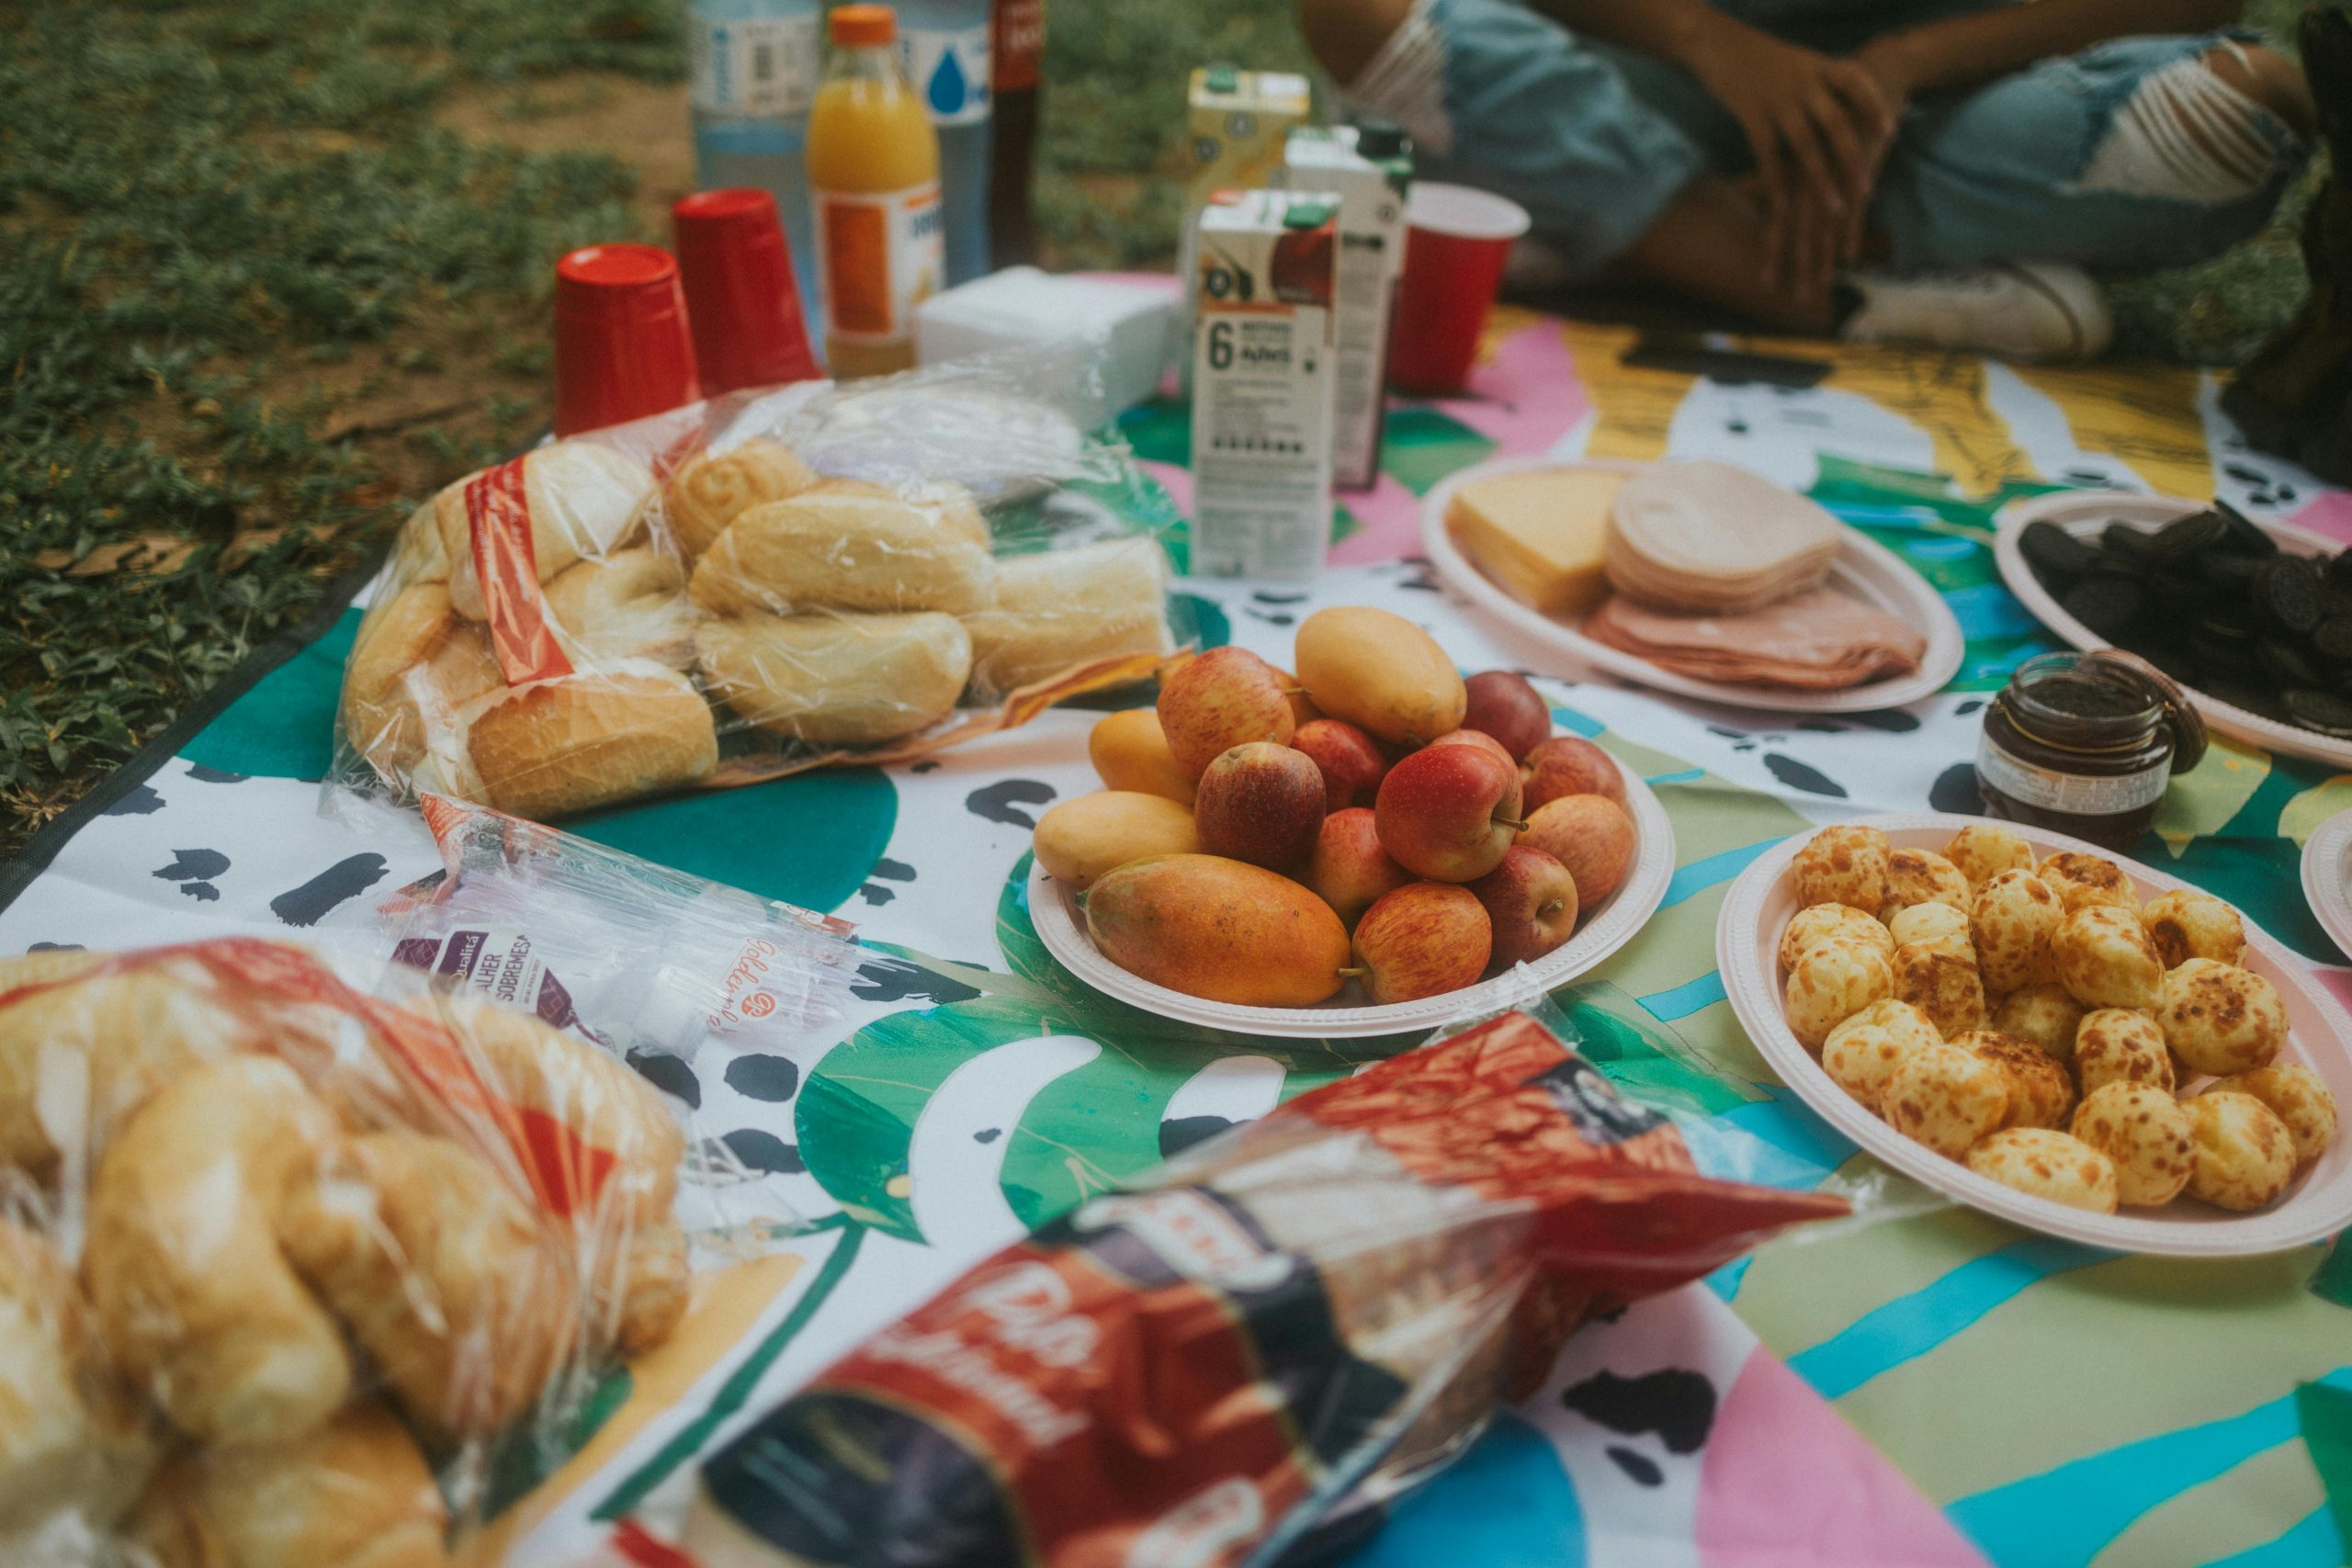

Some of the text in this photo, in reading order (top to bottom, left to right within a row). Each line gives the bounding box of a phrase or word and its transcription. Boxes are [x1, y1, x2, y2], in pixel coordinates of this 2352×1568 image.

[1208, 321, 1233, 369] 6
[474, 953, 503, 994] ALHER
[495, 934, 531, 1002] SOBREMESA
